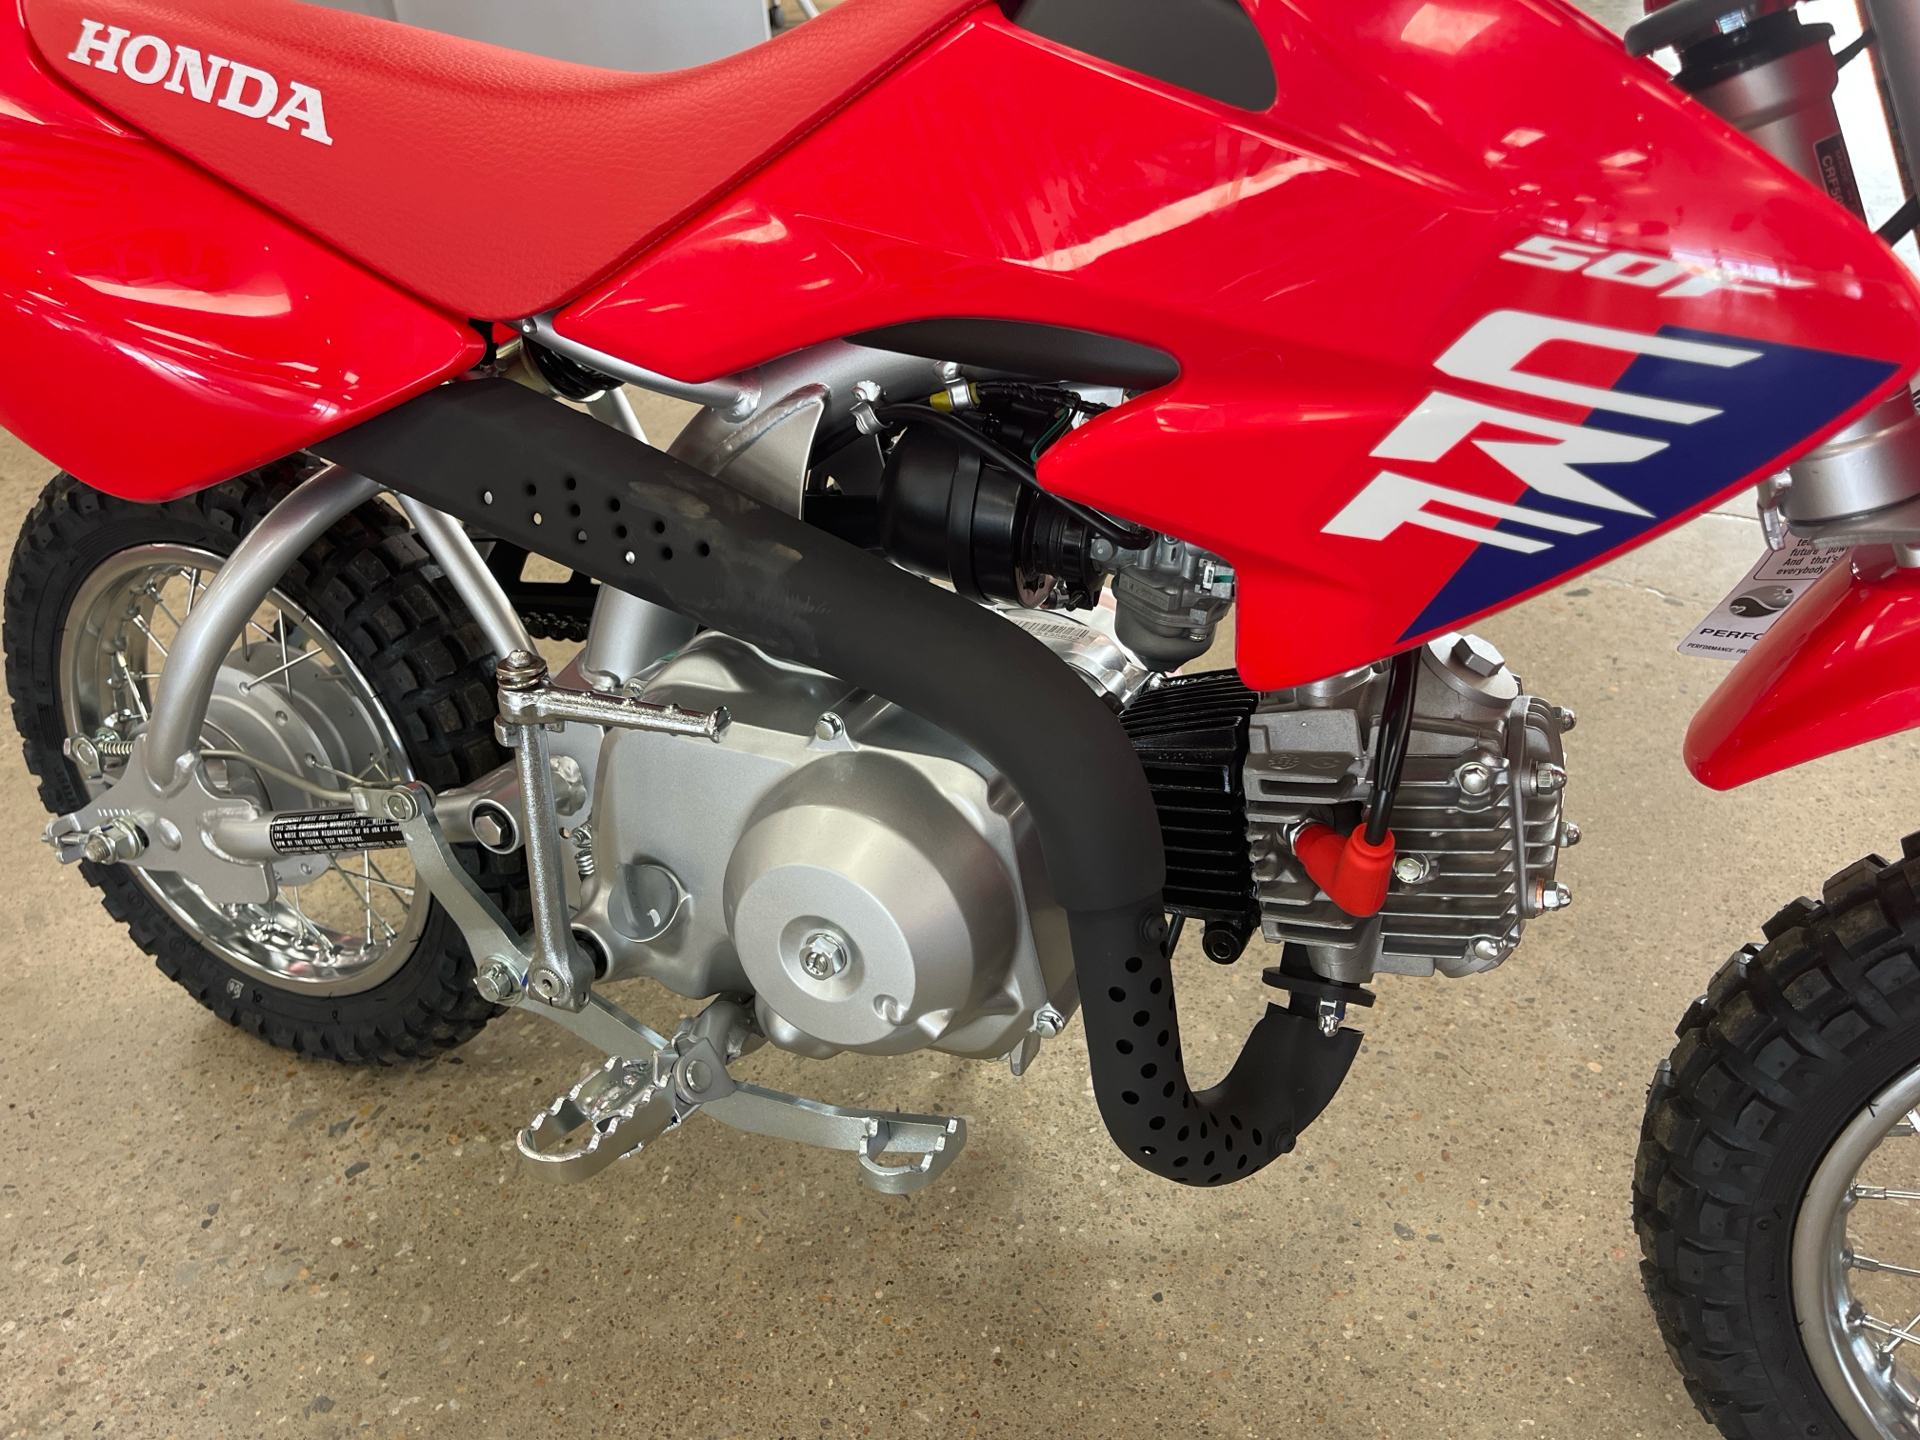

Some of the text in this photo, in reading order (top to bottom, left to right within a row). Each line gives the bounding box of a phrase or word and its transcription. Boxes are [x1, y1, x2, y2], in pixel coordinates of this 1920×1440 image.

[67, 19, 333, 146] HONDA
[1500, 235, 1815, 298] 50F
[1320, 310, 1764, 554] CRF
[1790, 548, 1820, 556] future
[1783, 555, 1838, 566] And that's
[1776, 566, 1826, 575] everybody
[1687, 643, 1733, 653] PERFORMANCE
